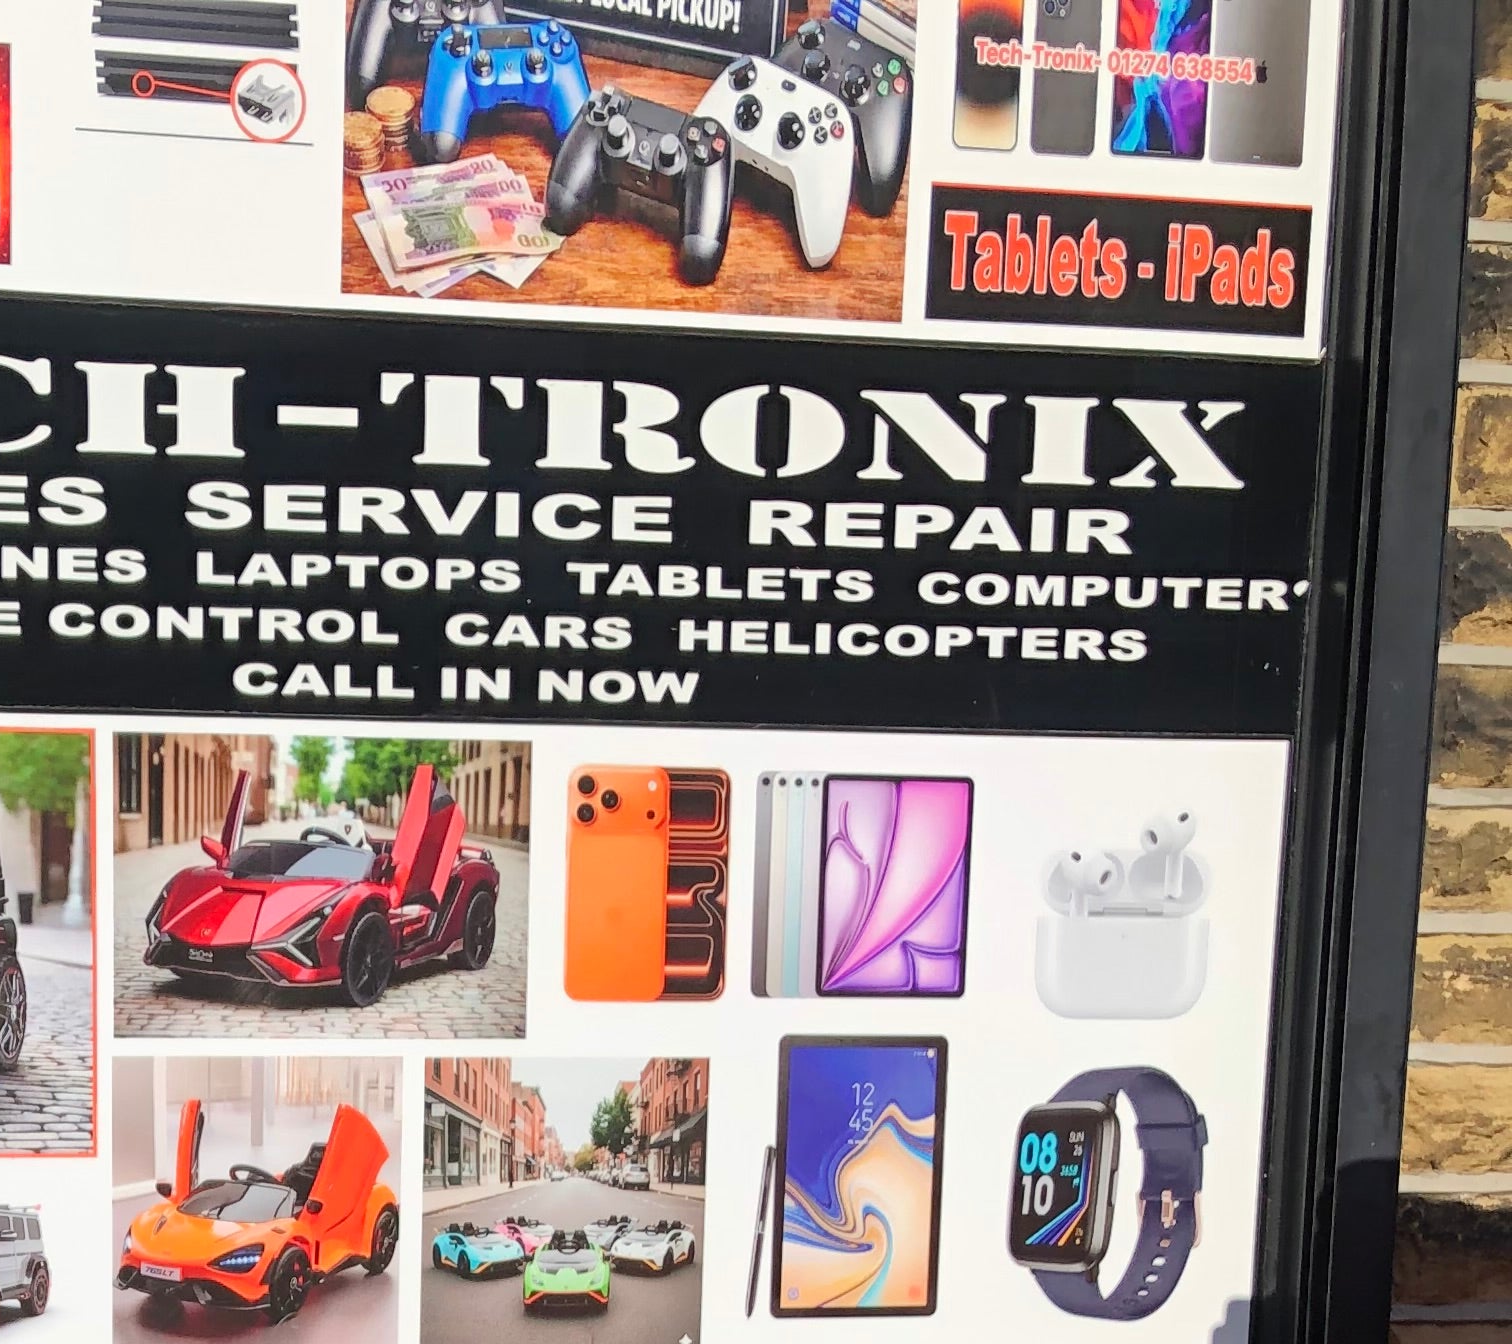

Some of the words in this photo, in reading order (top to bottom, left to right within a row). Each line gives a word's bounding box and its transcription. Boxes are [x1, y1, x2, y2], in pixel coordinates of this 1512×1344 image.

[656, 0, 740, 34] PICKUP!
[1106, 51, 1170, 79] 01274
[1172, 52, 1255, 85] 638554
[944, 210, 1128, 299] Tablets
[1164, 223, 1295, 309] iPads
[185, 481, 673, 544] SERVICE
[749, 500, 1133, 555] REPAIR
[197, 552, 522, 595] LAPTOPS
[567, 562, 874, 603] TABLETS
[918, 572, 1310, 611] COMPUTER
[49, 603, 400, 645] CONTROL
[446, 613, 633, 650] CARS
[679, 620, 1148, 662] HELICOPTERS
[233, 663, 414, 700] CALL
[441, 667, 510, 701] IN
[539, 670, 700, 704] NOW
[852, 1082, 875, 1106] 12
[848, 1108, 874, 1132] 45
[1020, 1131, 1058, 1174] 08
[1021, 1175, 1055, 1216] 10
